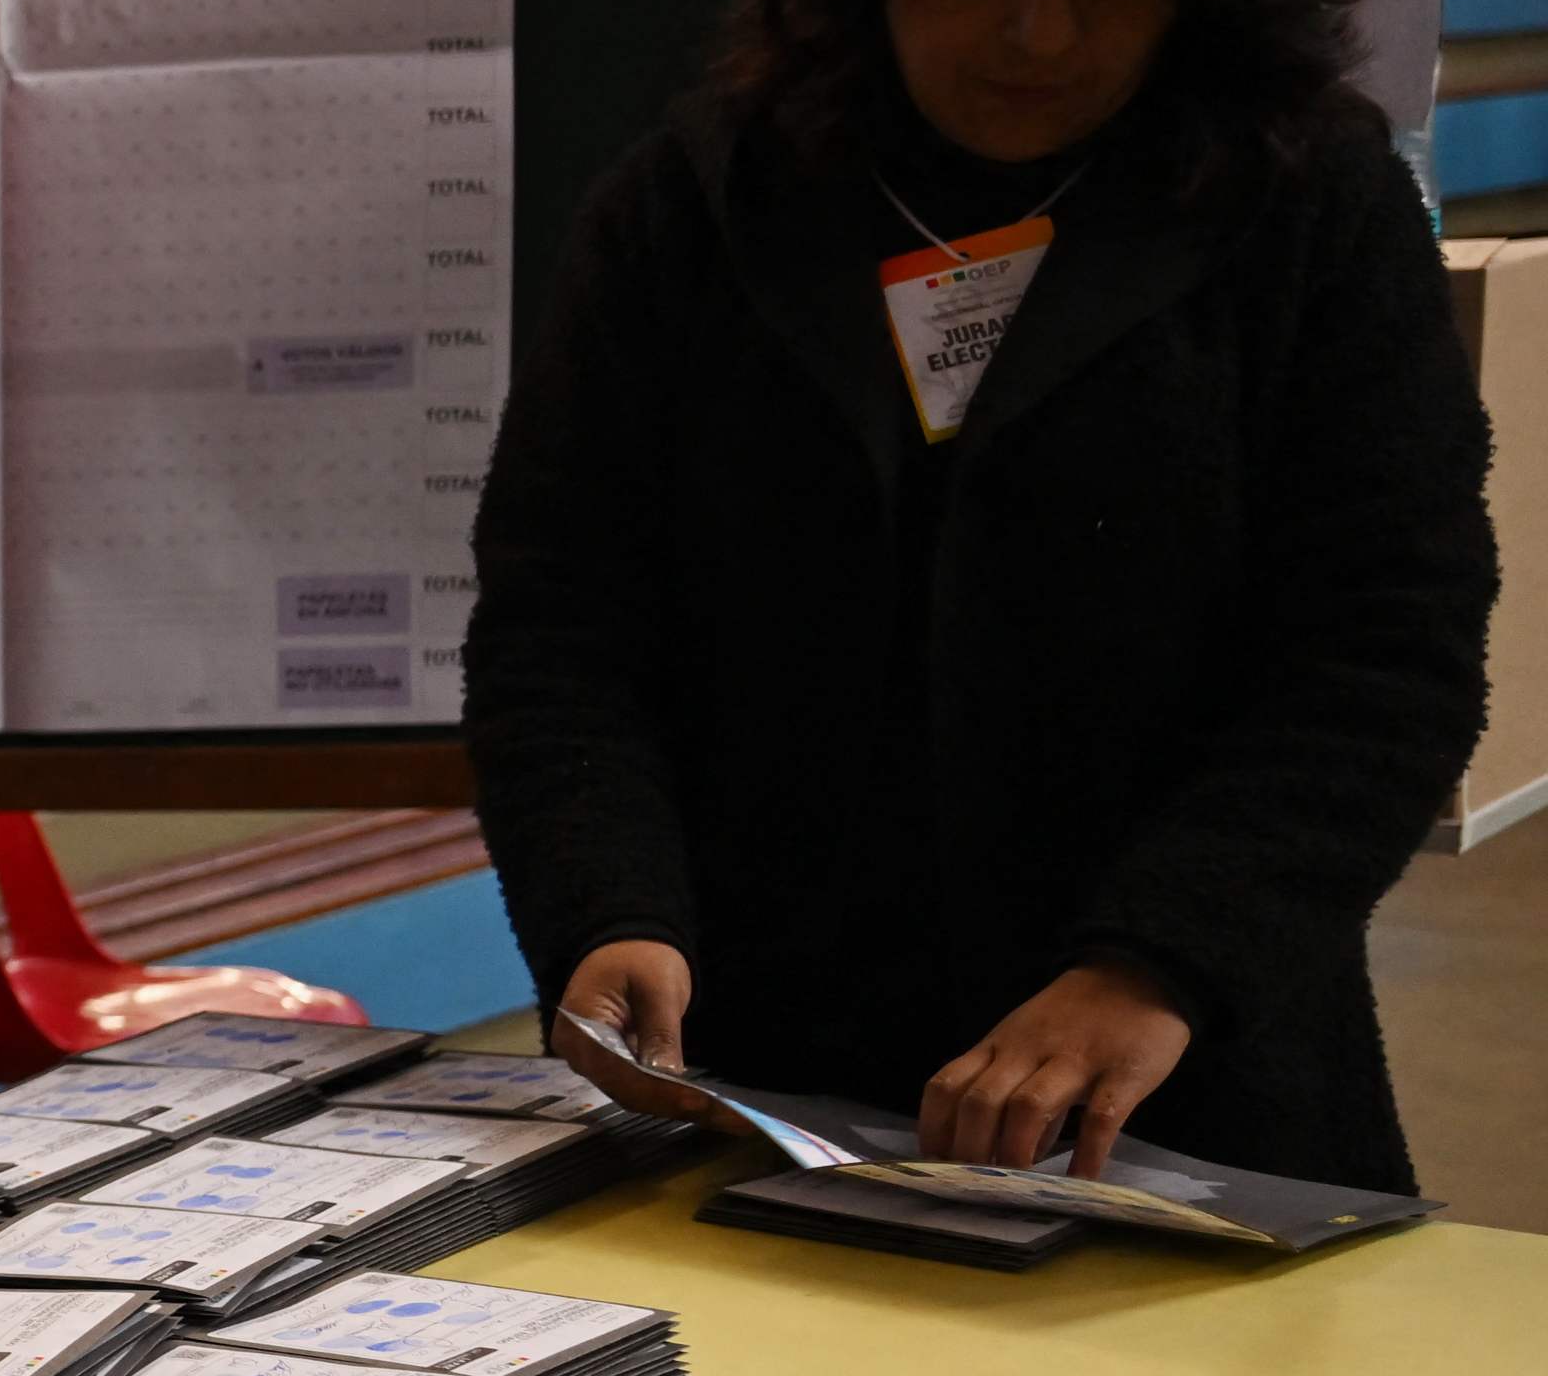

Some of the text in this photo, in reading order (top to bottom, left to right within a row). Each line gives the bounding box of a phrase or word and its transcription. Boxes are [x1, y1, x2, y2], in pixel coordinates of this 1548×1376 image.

[968, 259, 1013, 282] OEP
[941, 314, 1012, 349] JURA
[925, 337, 1000, 373] ELECT
